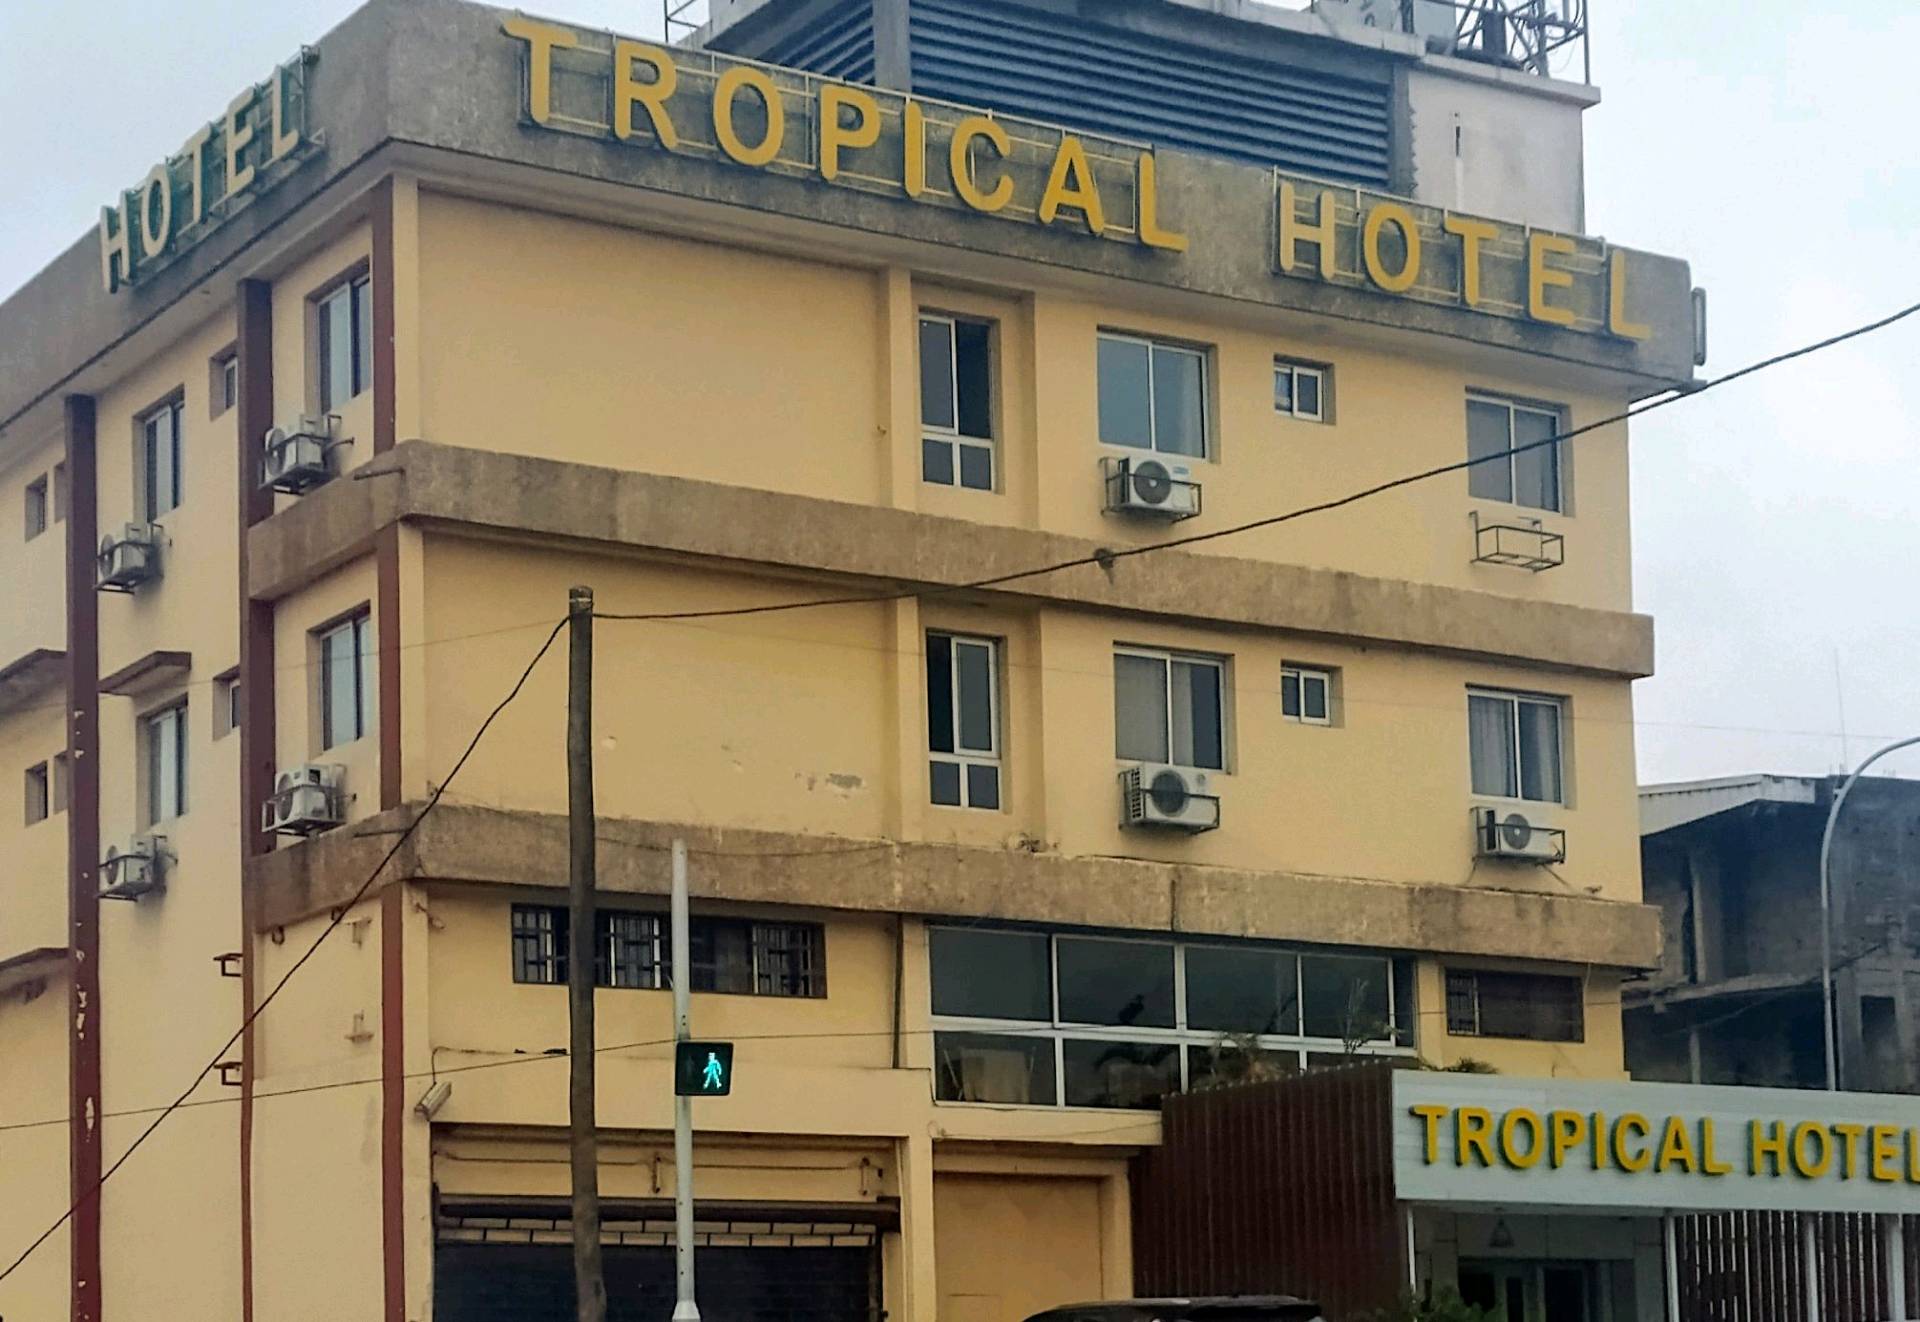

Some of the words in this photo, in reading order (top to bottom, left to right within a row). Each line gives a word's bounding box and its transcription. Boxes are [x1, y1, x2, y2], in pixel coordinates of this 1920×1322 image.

[100, 64, 302, 294] HOTEL
[503, 19, 1189, 252] TROPICAL
[1279, 181, 1652, 341] HOTEL
[1410, 1105, 1732, 1175] TROPICAL
